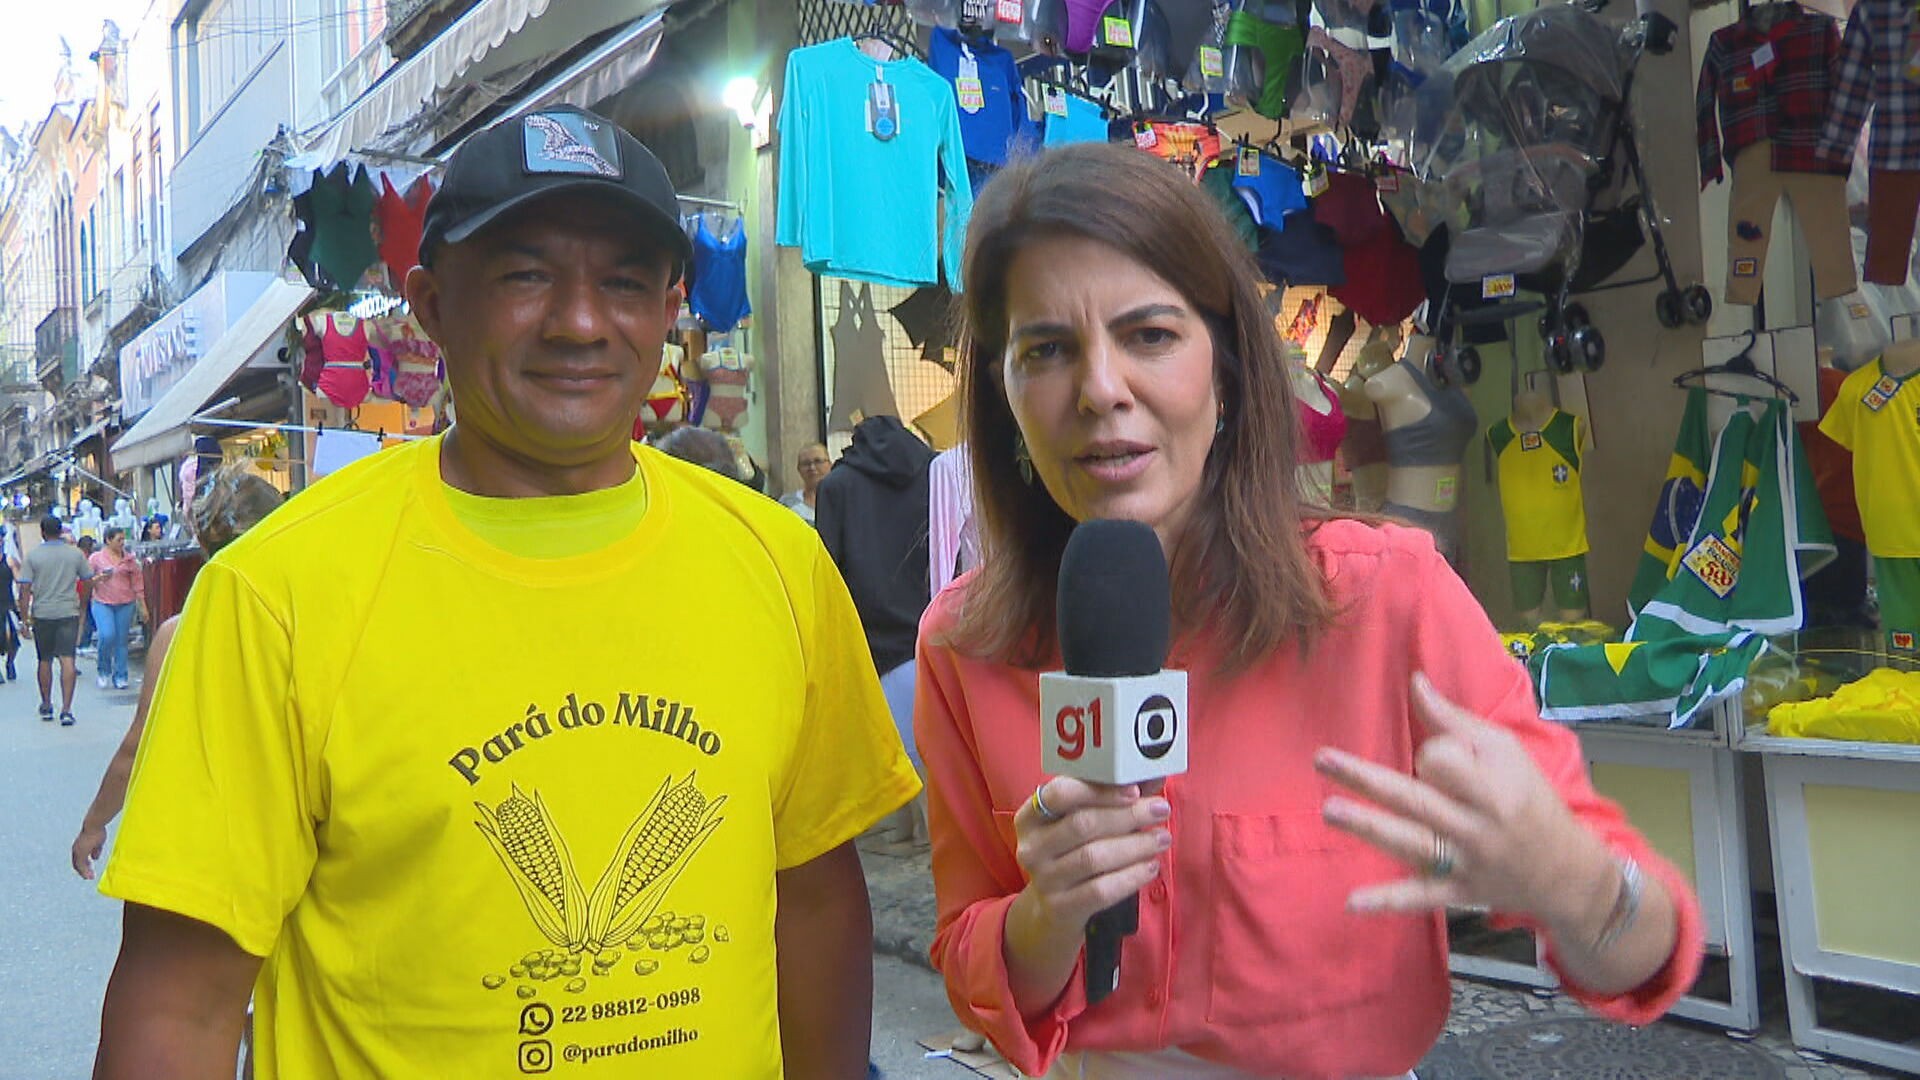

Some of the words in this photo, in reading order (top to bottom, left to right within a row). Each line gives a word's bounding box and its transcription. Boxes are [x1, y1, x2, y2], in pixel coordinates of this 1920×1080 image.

[448, 703, 553, 785] Pará
[557, 692, 606, 730] do
[612, 692, 722, 756] Milho
[1056, 697, 1102, 761] g1
[561, 1005, 587, 1024] 22
[591, 987, 701, 1021] 98812-0998
[562, 1027, 699, 1064] @paradomilho
